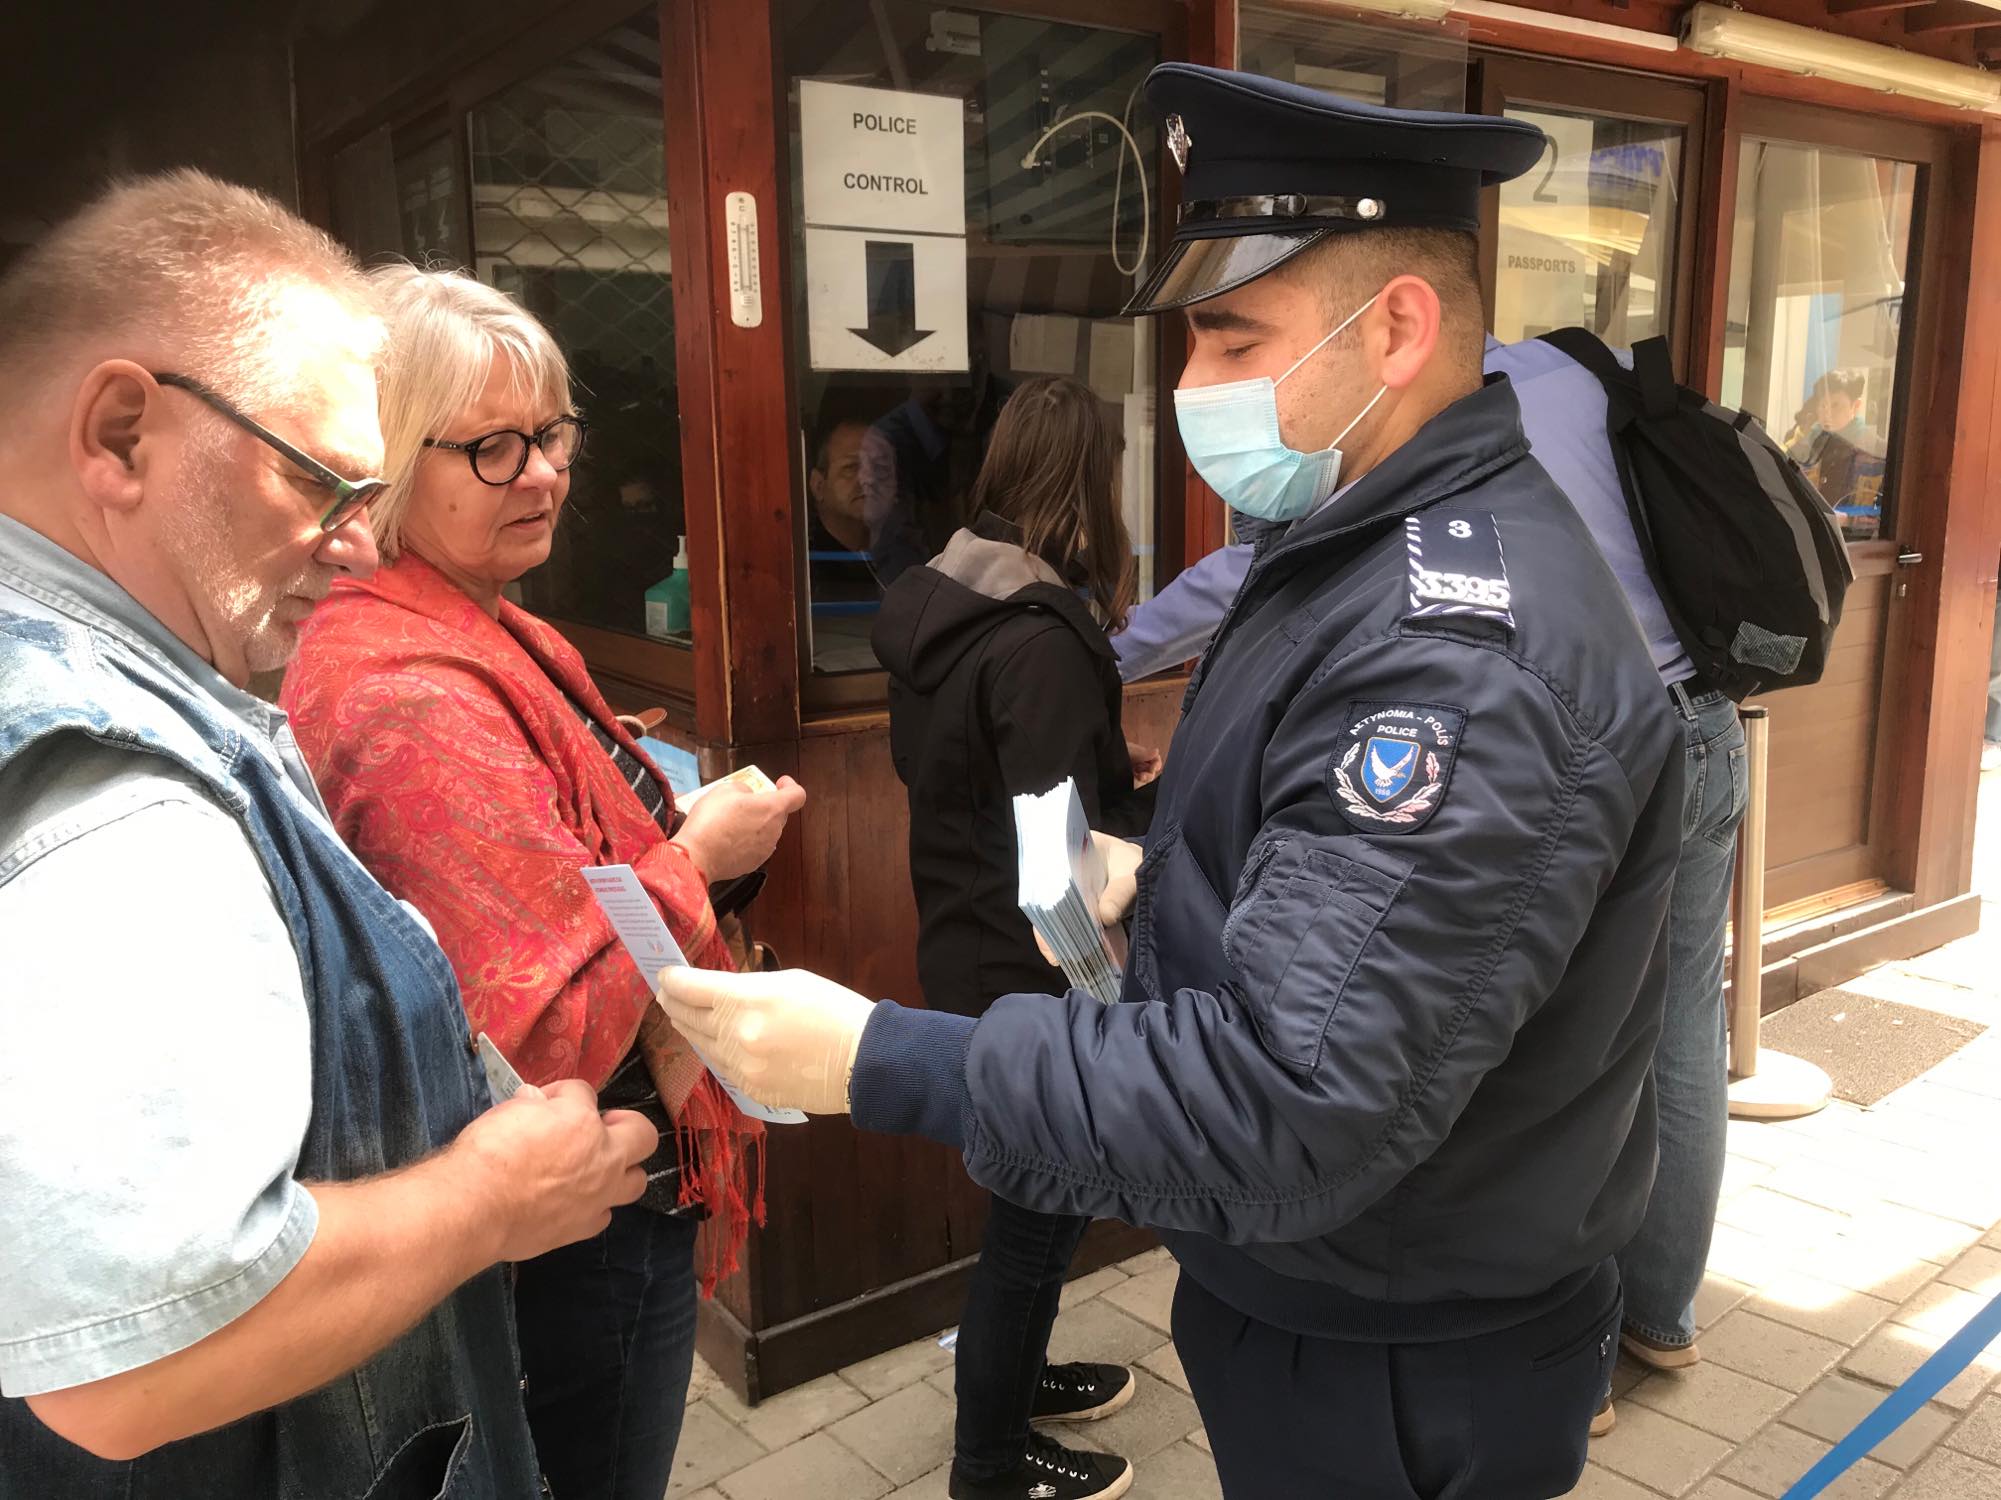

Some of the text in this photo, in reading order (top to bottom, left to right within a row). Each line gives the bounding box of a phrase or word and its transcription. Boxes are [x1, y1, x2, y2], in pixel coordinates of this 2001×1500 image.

[853, 112, 917, 135] POLICE
[1533, 134, 1559, 204] 2
[844, 172, 929, 195] CONTROL
[1508, 255, 1576, 273] PASSPORTS
[1448, 519, 1473, 538] 3
[1376, 724, 1418, 738] POLICE
